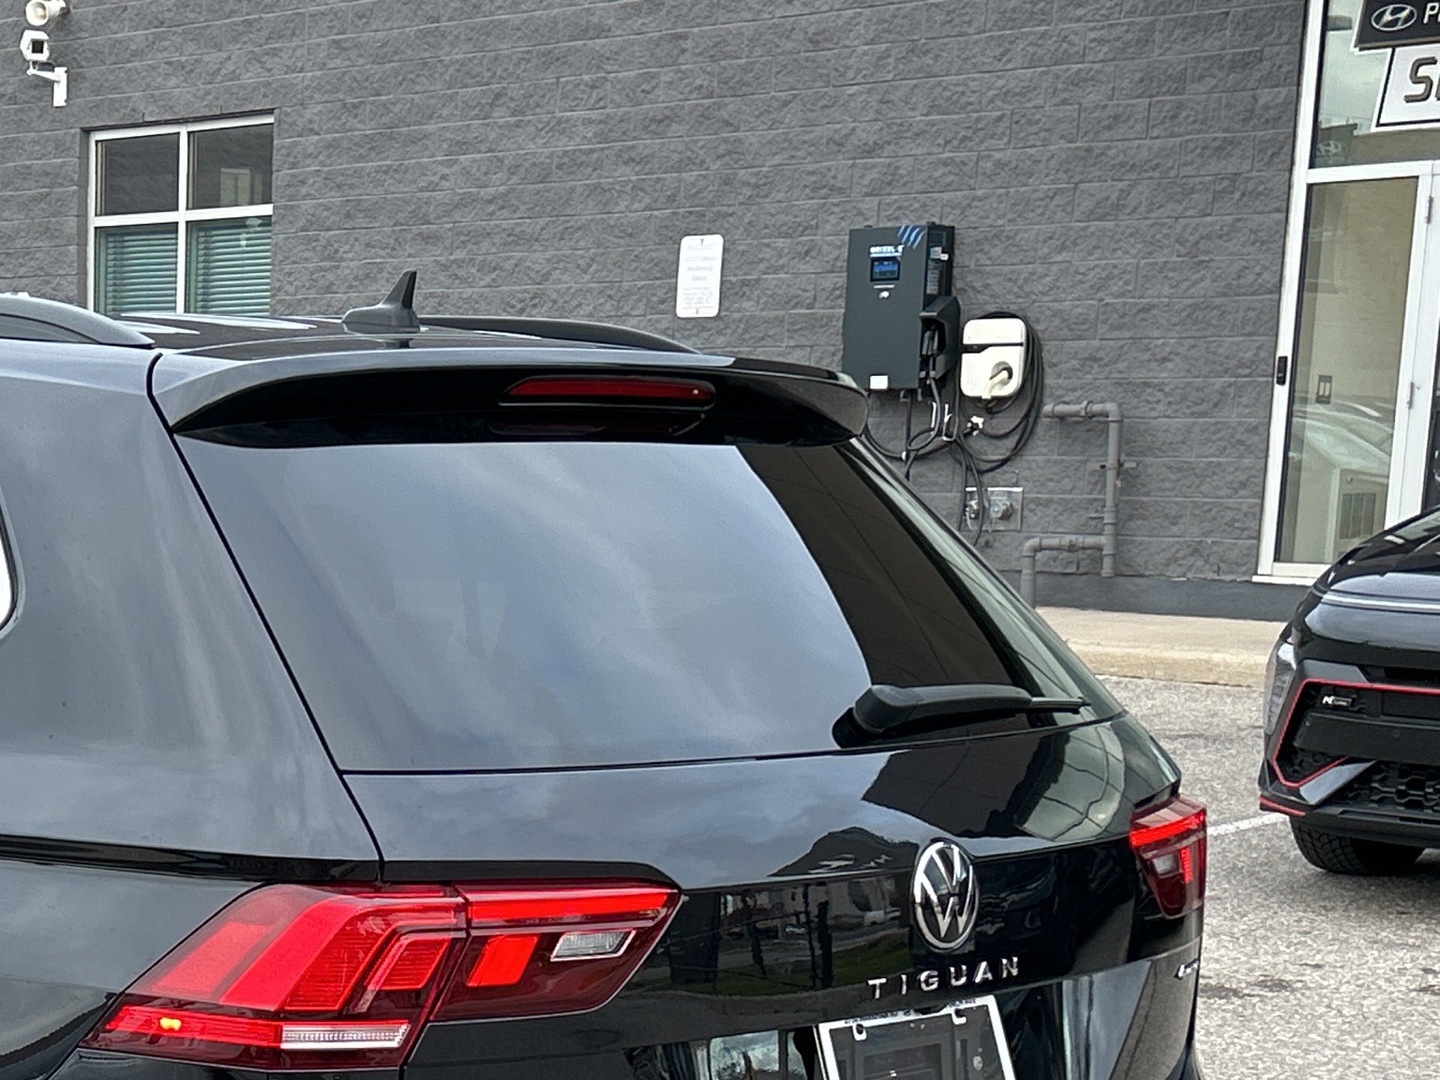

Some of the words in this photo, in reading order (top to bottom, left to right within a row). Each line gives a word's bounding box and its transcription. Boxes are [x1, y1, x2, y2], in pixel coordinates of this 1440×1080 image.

[1423, 2, 1440, 25] P
[1403, 56, 1440, 103] S
[867, 956, 1019, 1000] TIGUAN
